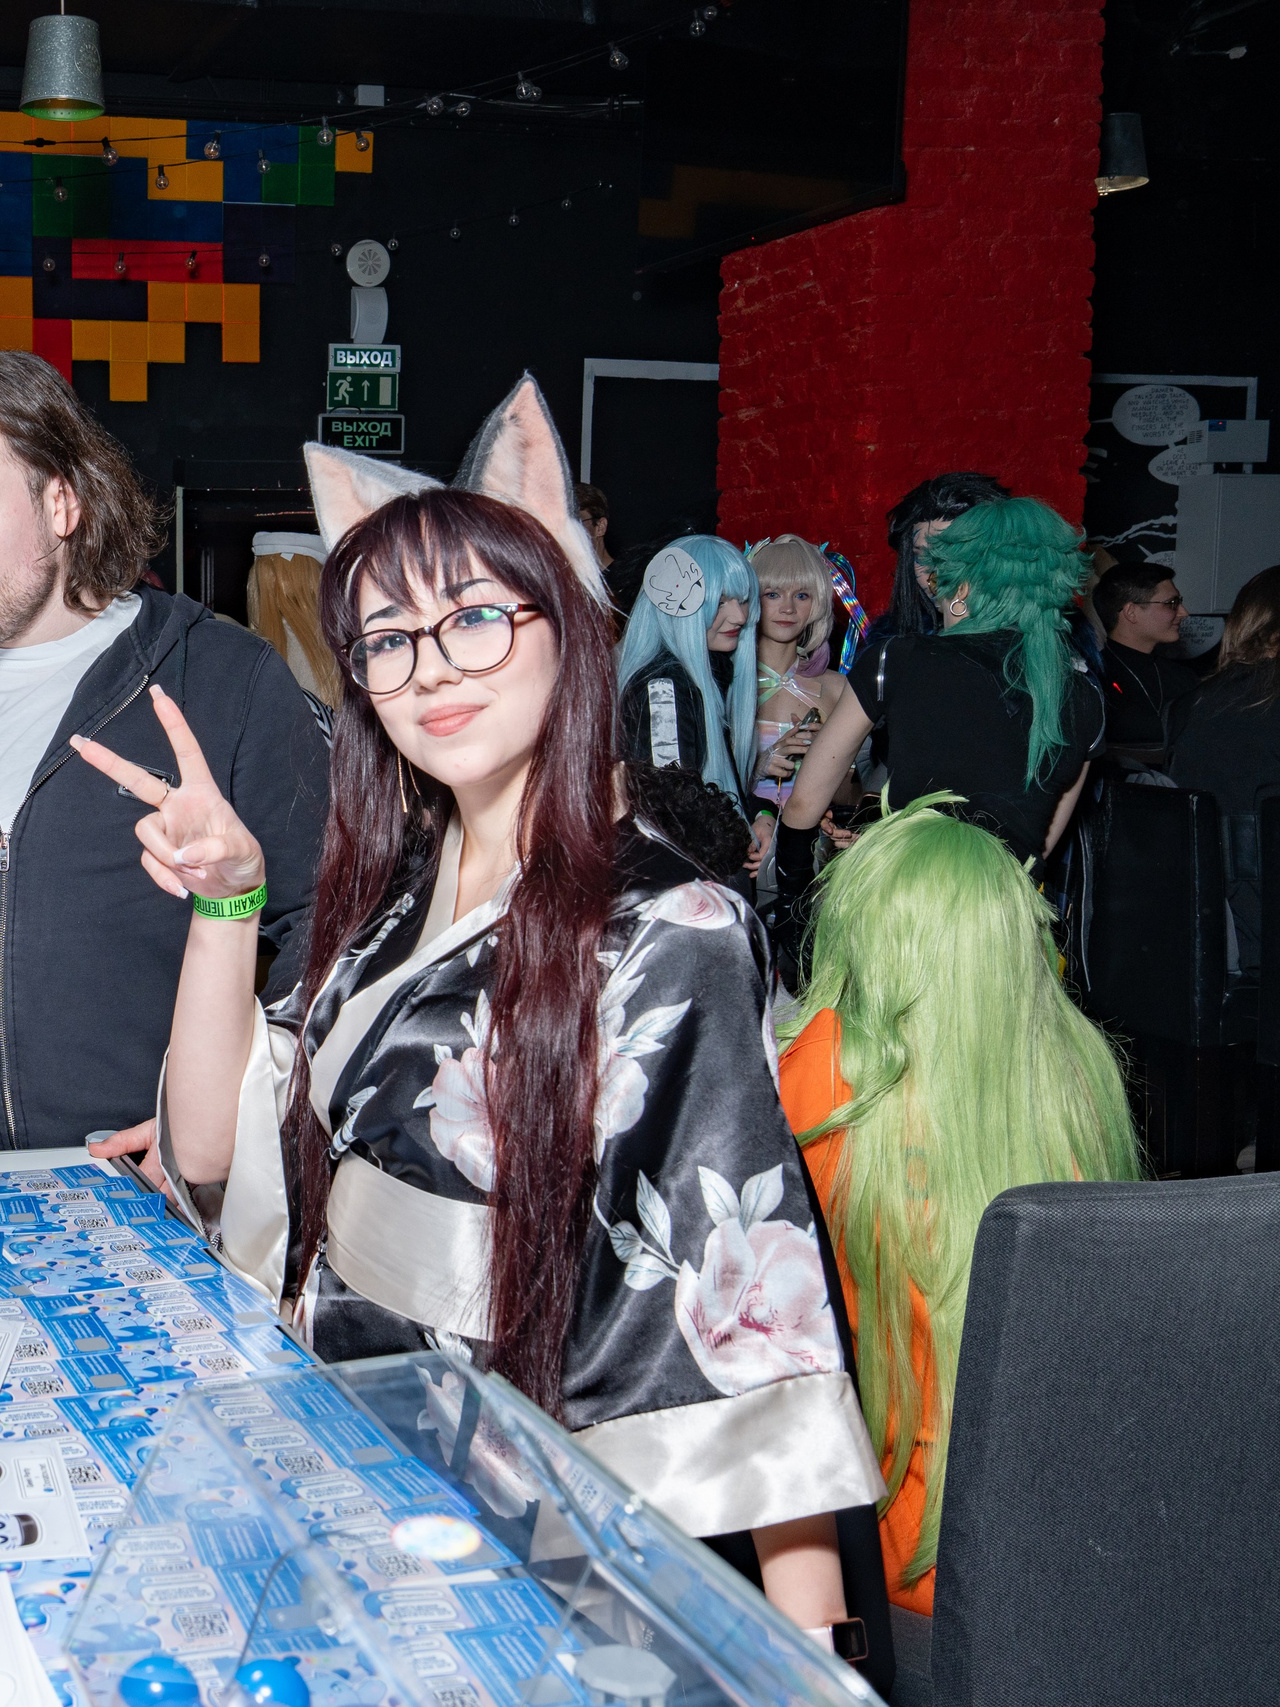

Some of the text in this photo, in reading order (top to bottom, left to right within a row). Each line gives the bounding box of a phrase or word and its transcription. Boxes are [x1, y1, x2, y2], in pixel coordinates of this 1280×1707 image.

[336, 351, 392, 367] ВЫХОД
[331, 421, 392, 437] ВЫХОД
[343, 435, 380, 447] EXIT
[193, 894, 226, 917] ПЕППЕ
